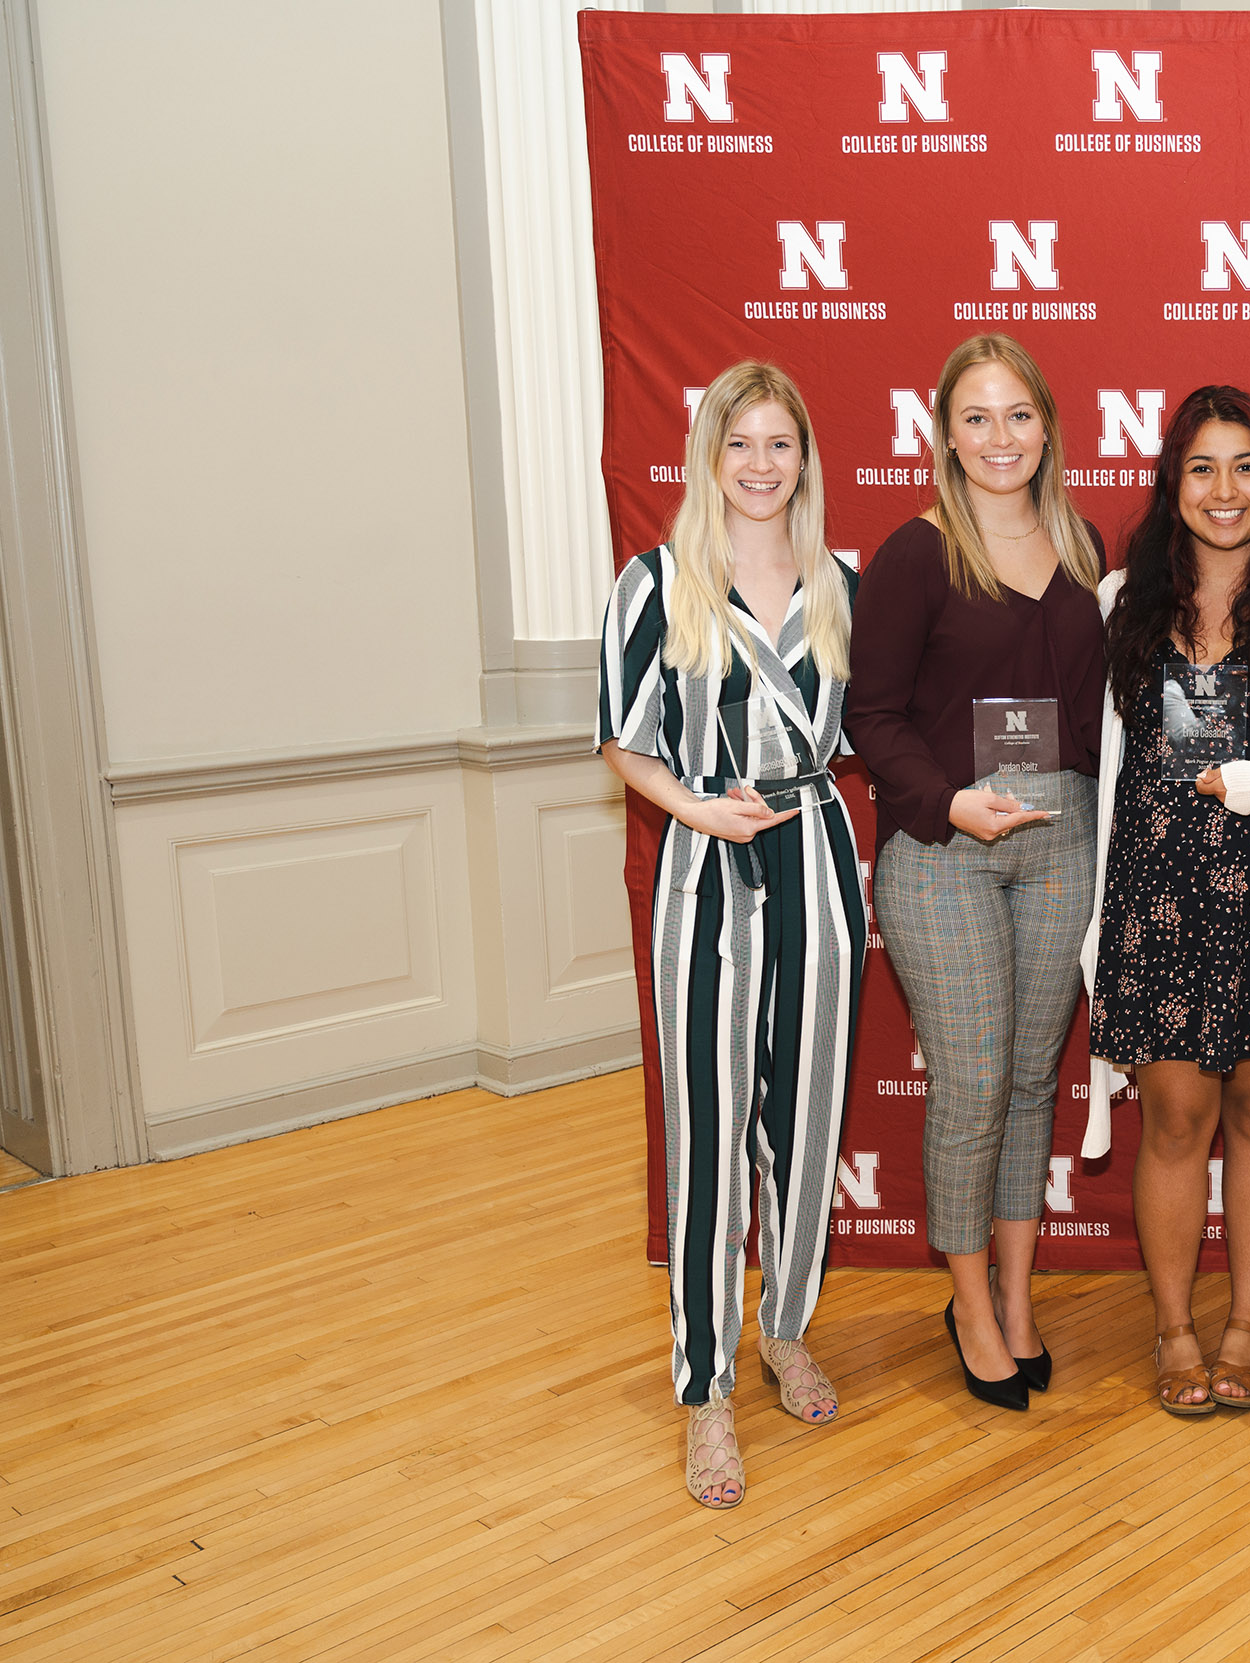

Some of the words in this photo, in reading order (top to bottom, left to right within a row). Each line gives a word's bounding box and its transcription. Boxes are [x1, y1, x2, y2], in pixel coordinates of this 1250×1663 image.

[660, 52, 734, 123] N
[877, 50, 949, 123] N
[1091, 50, 1163, 122] N
[628, 134, 684, 152] COLLEGE
[687, 135, 703, 153] OF
[707, 135, 773, 153] BUSINESS
[842, 135, 898, 153] COLLEGE
[902, 135, 917, 153] OF
[922, 134, 987, 152] BUSINESS
[1055, 134, 1111, 152] COLLEGE
[1115, 134, 1131, 152] OF
[1135, 135, 1201, 152] BUSINESS
[777, 221, 848, 290] N
[989, 220, 1059, 290] N
[745, 302, 798, 319] COLLEGE
[803, 302, 817, 319] OF
[822, 303, 886, 320] BUSINESS
[954, 303, 1008, 320] COLLEGE
[1013, 303, 1028, 320] OF
[1032, 303, 1096, 320] BUSINESS
[1164, 303, 1218, 320] COLLEGE
[1223, 303, 1238, 320] OF
[1098, 389, 1165, 458] N
[856, 468, 910, 485] COLLEGE
[914, 468, 928, 485] OF
[1064, 470, 1115, 486] COLLEGE
[1120, 470, 1134, 486] OF
[1195, 674, 1217, 696] N
[1005, 711, 1028, 732] N
[1183, 727, 1199, 737] Erika
[998, 762, 1020, 772] Jordan
[1021, 761, 1038, 772] Seitz
[877, 1080, 928, 1096] COLLEGE
[838, 1219, 852, 1235] OF
[856, 1219, 916, 1235] BUSINESS
[1050, 1222, 1110, 1237] BUSINESS
